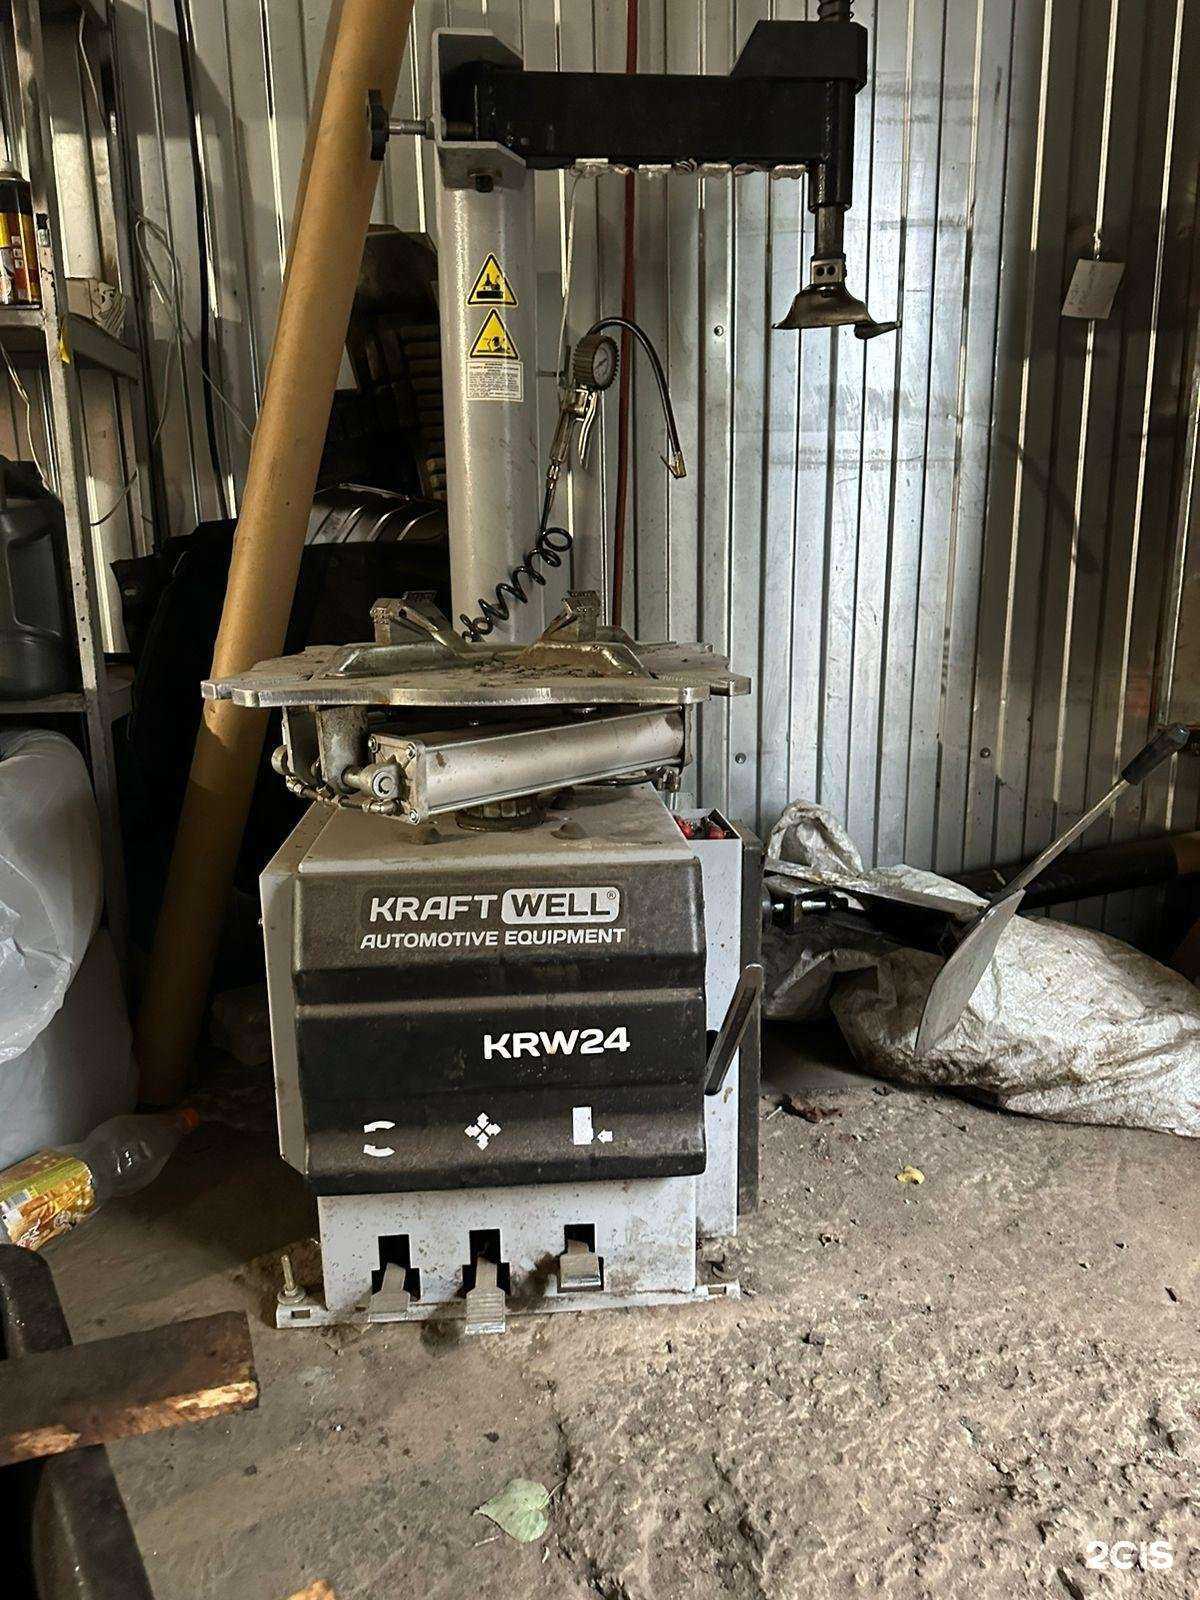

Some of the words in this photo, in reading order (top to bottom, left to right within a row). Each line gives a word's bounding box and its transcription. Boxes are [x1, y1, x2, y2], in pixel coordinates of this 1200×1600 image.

[369, 894, 498, 922] KRAFT
[360, 931, 499, 950] AUTOMOTIVE
[504, 928, 626, 946] EQUIPMENT
[483, 1026, 631, 1060] KRW24
